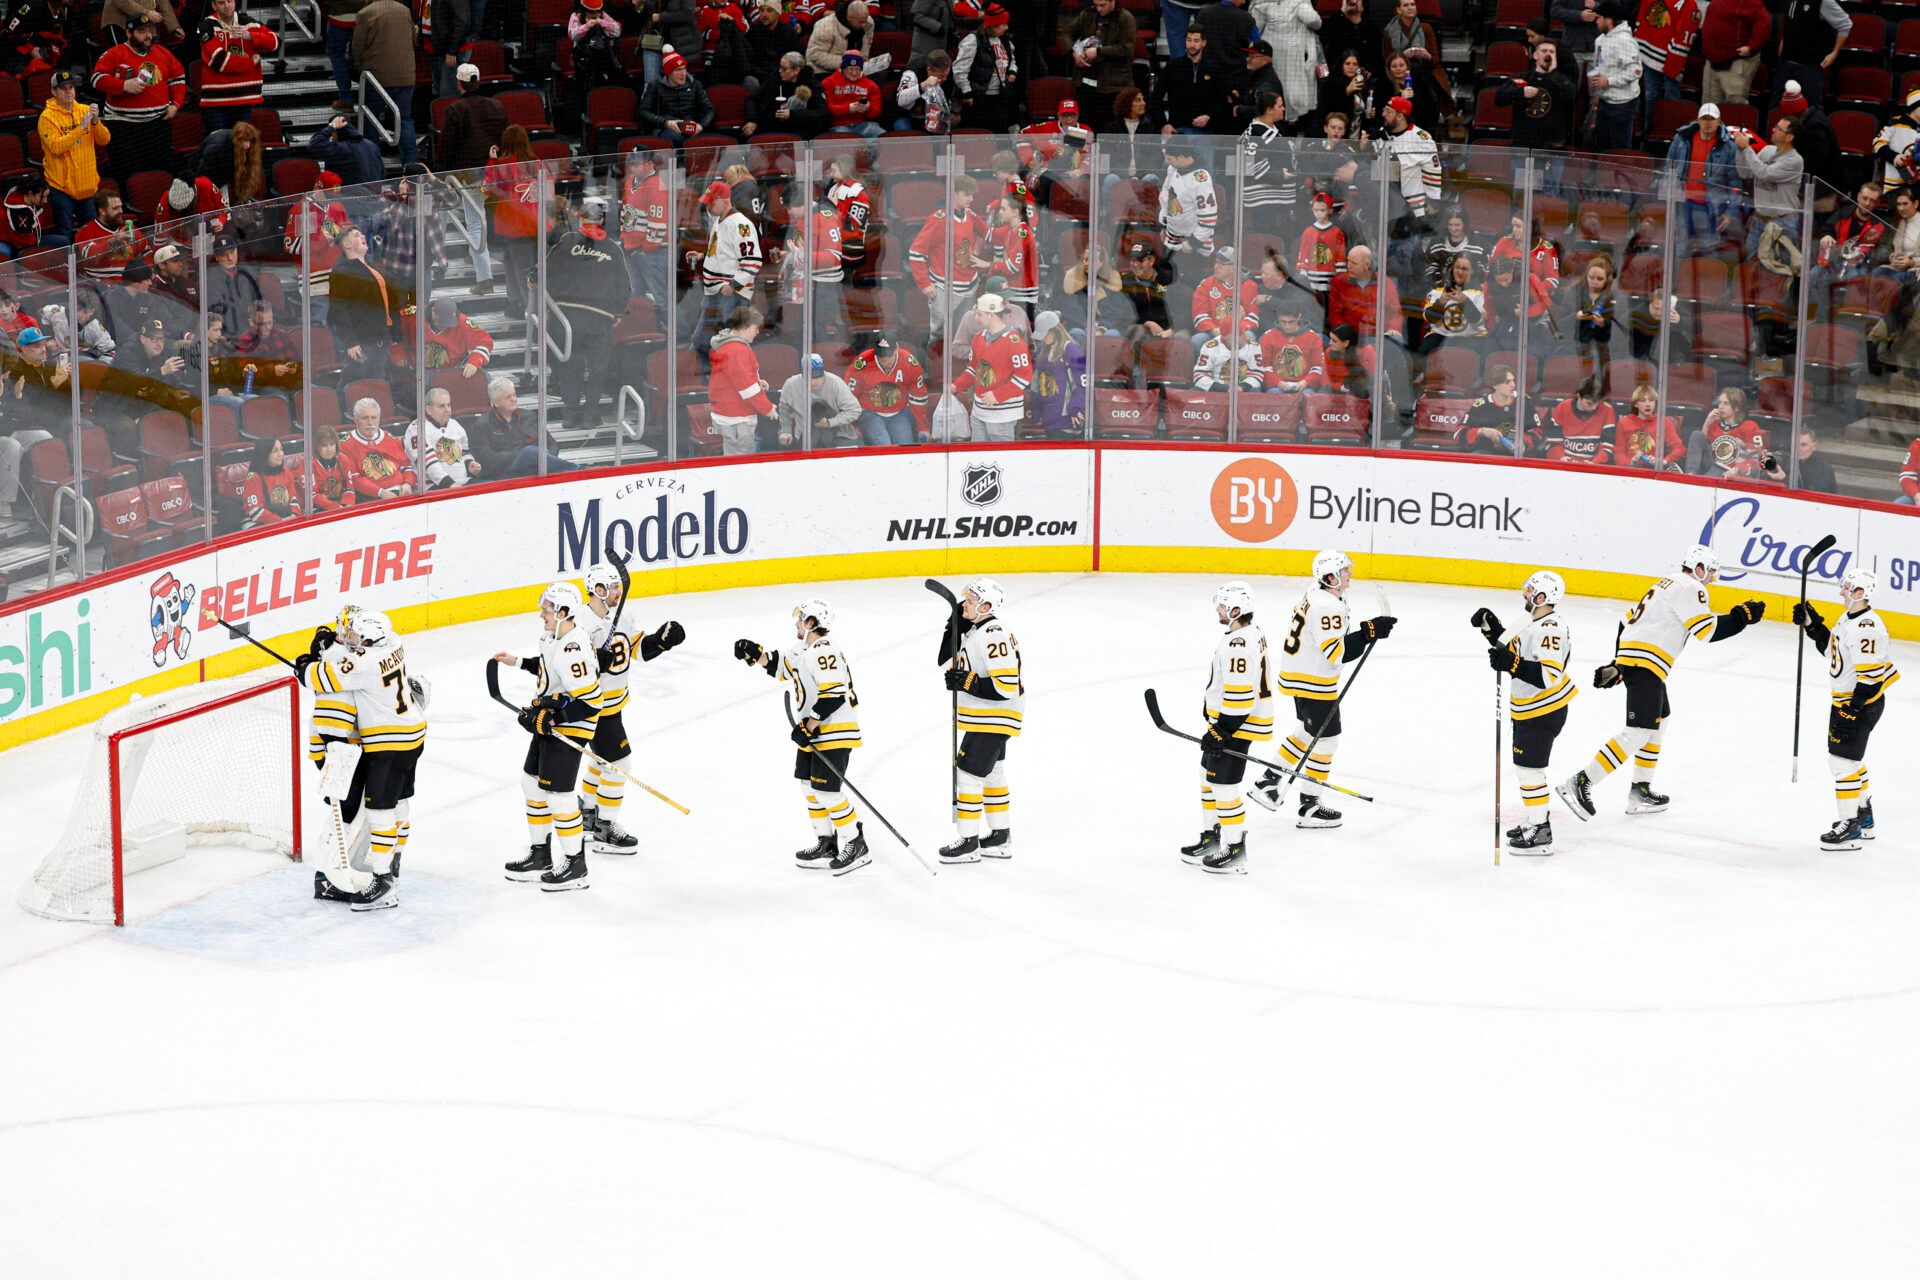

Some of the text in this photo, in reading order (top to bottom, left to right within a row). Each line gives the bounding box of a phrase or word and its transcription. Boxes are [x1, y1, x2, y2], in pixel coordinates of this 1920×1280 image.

[1195, 193, 1217, 210] 24
[650, 205, 664, 219] 98
[850, 205, 866, 220] 88
[571, 244, 612, 263] Chicago
[738, 241, 755, 257] 27
[1536, 251, 1545, 261] C
[1012, 353, 1029, 369] 98
[895, 369, 904, 383] A
[916, 375, 924, 389] 2
[1112, 409, 1131, 418] CIBC
[1182, 410, 1203, 420] CIBC
[1251, 413, 1271, 422] CIBC
[1321, 413, 1341, 422] CIBC
[1430, 414, 1450, 424] CIBC
[1564, 439, 1598, 452] CHICAG
[1752, 435, 1763, 448] 9
[615, 477, 686, 500] CERVEZA
[970, 474, 996, 499] NHL
[161, 499, 177, 511] CIBC
[1230, 477, 1282, 525] BY
[1309, 485, 1524, 532] Byline Bank
[116, 513, 130, 525] CIBC
[557, 489, 749, 572] Modelo
[1699, 497, 1853, 581] Circa
[198, 533, 437, 633] BELLE TIRE
[1321, 615, 1342, 631] 93
[987, 641, 1008, 659] 20
[1540, 635, 1561, 651] 45
[1860, 638, 1876, 654] 21
[571, 661, 589, 678] 91
[817, 654, 838, 671] 92
[1229, 658, 1247, 674] 18
